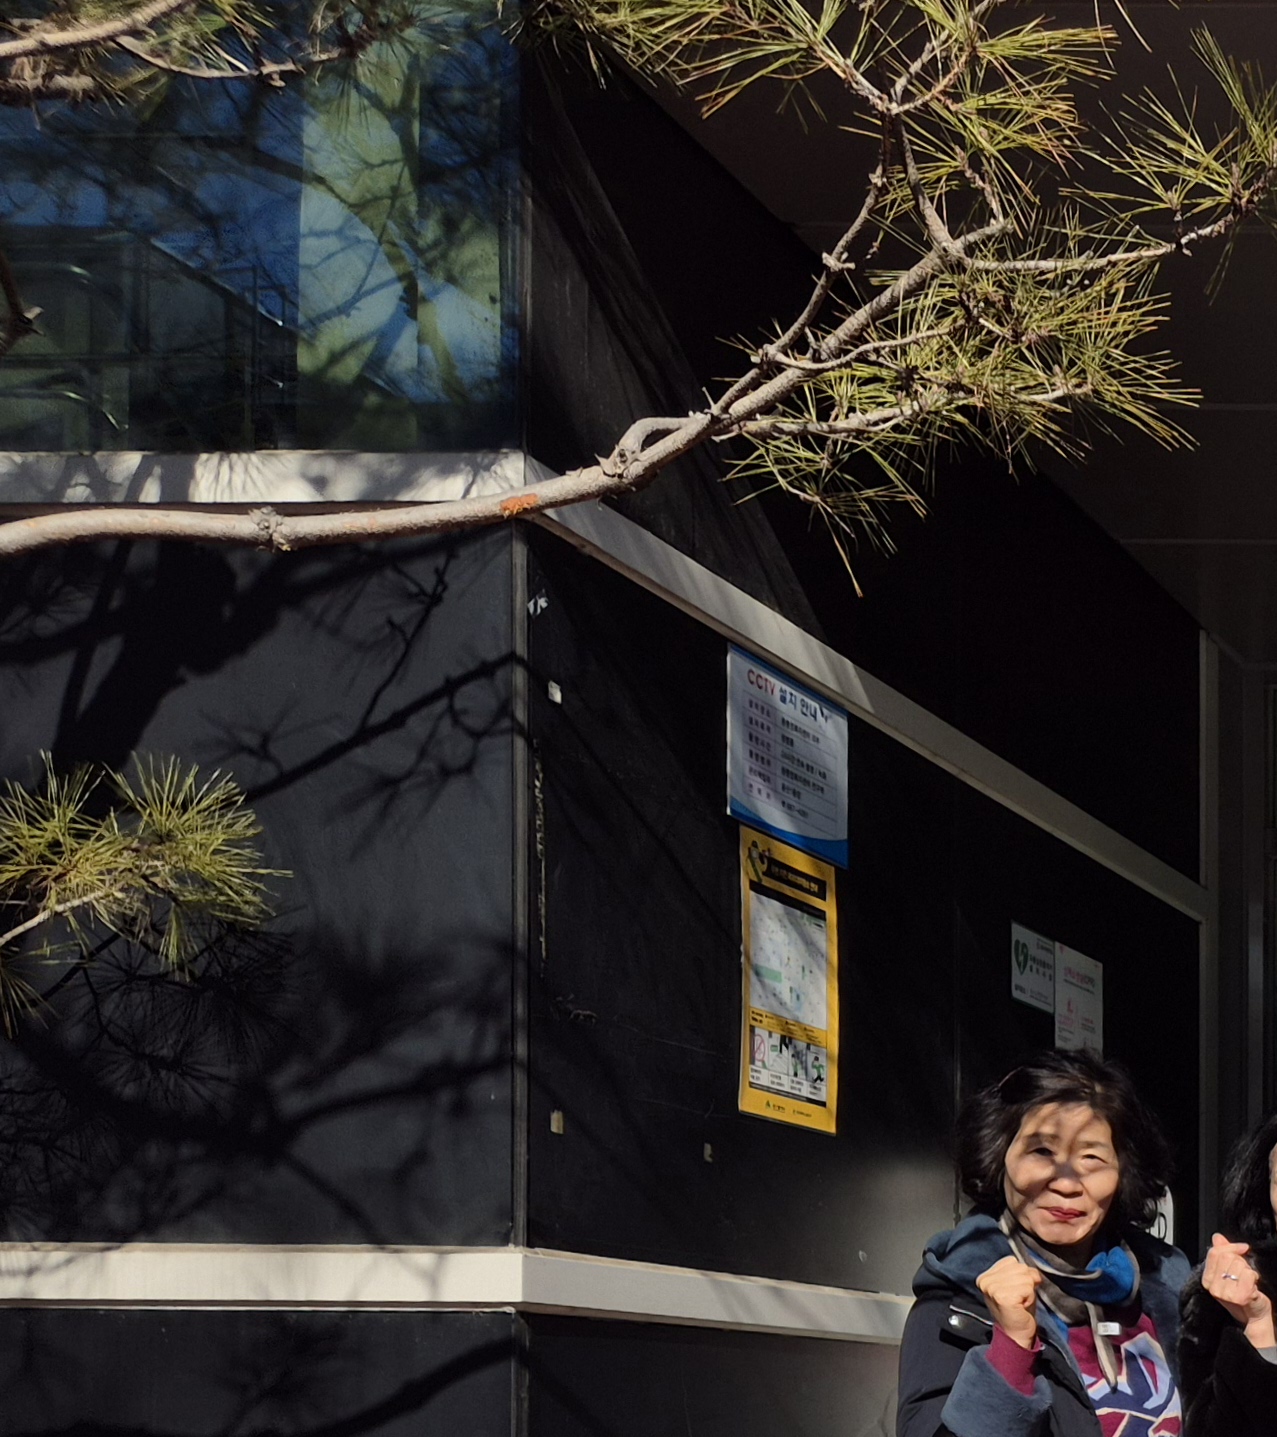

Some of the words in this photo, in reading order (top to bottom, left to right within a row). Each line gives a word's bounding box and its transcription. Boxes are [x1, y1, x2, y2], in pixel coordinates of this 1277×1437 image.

[747, 669, 775, 695] CCTV
[779, 686, 797, 710] 설치
[800, 697, 818, 722] 안내
